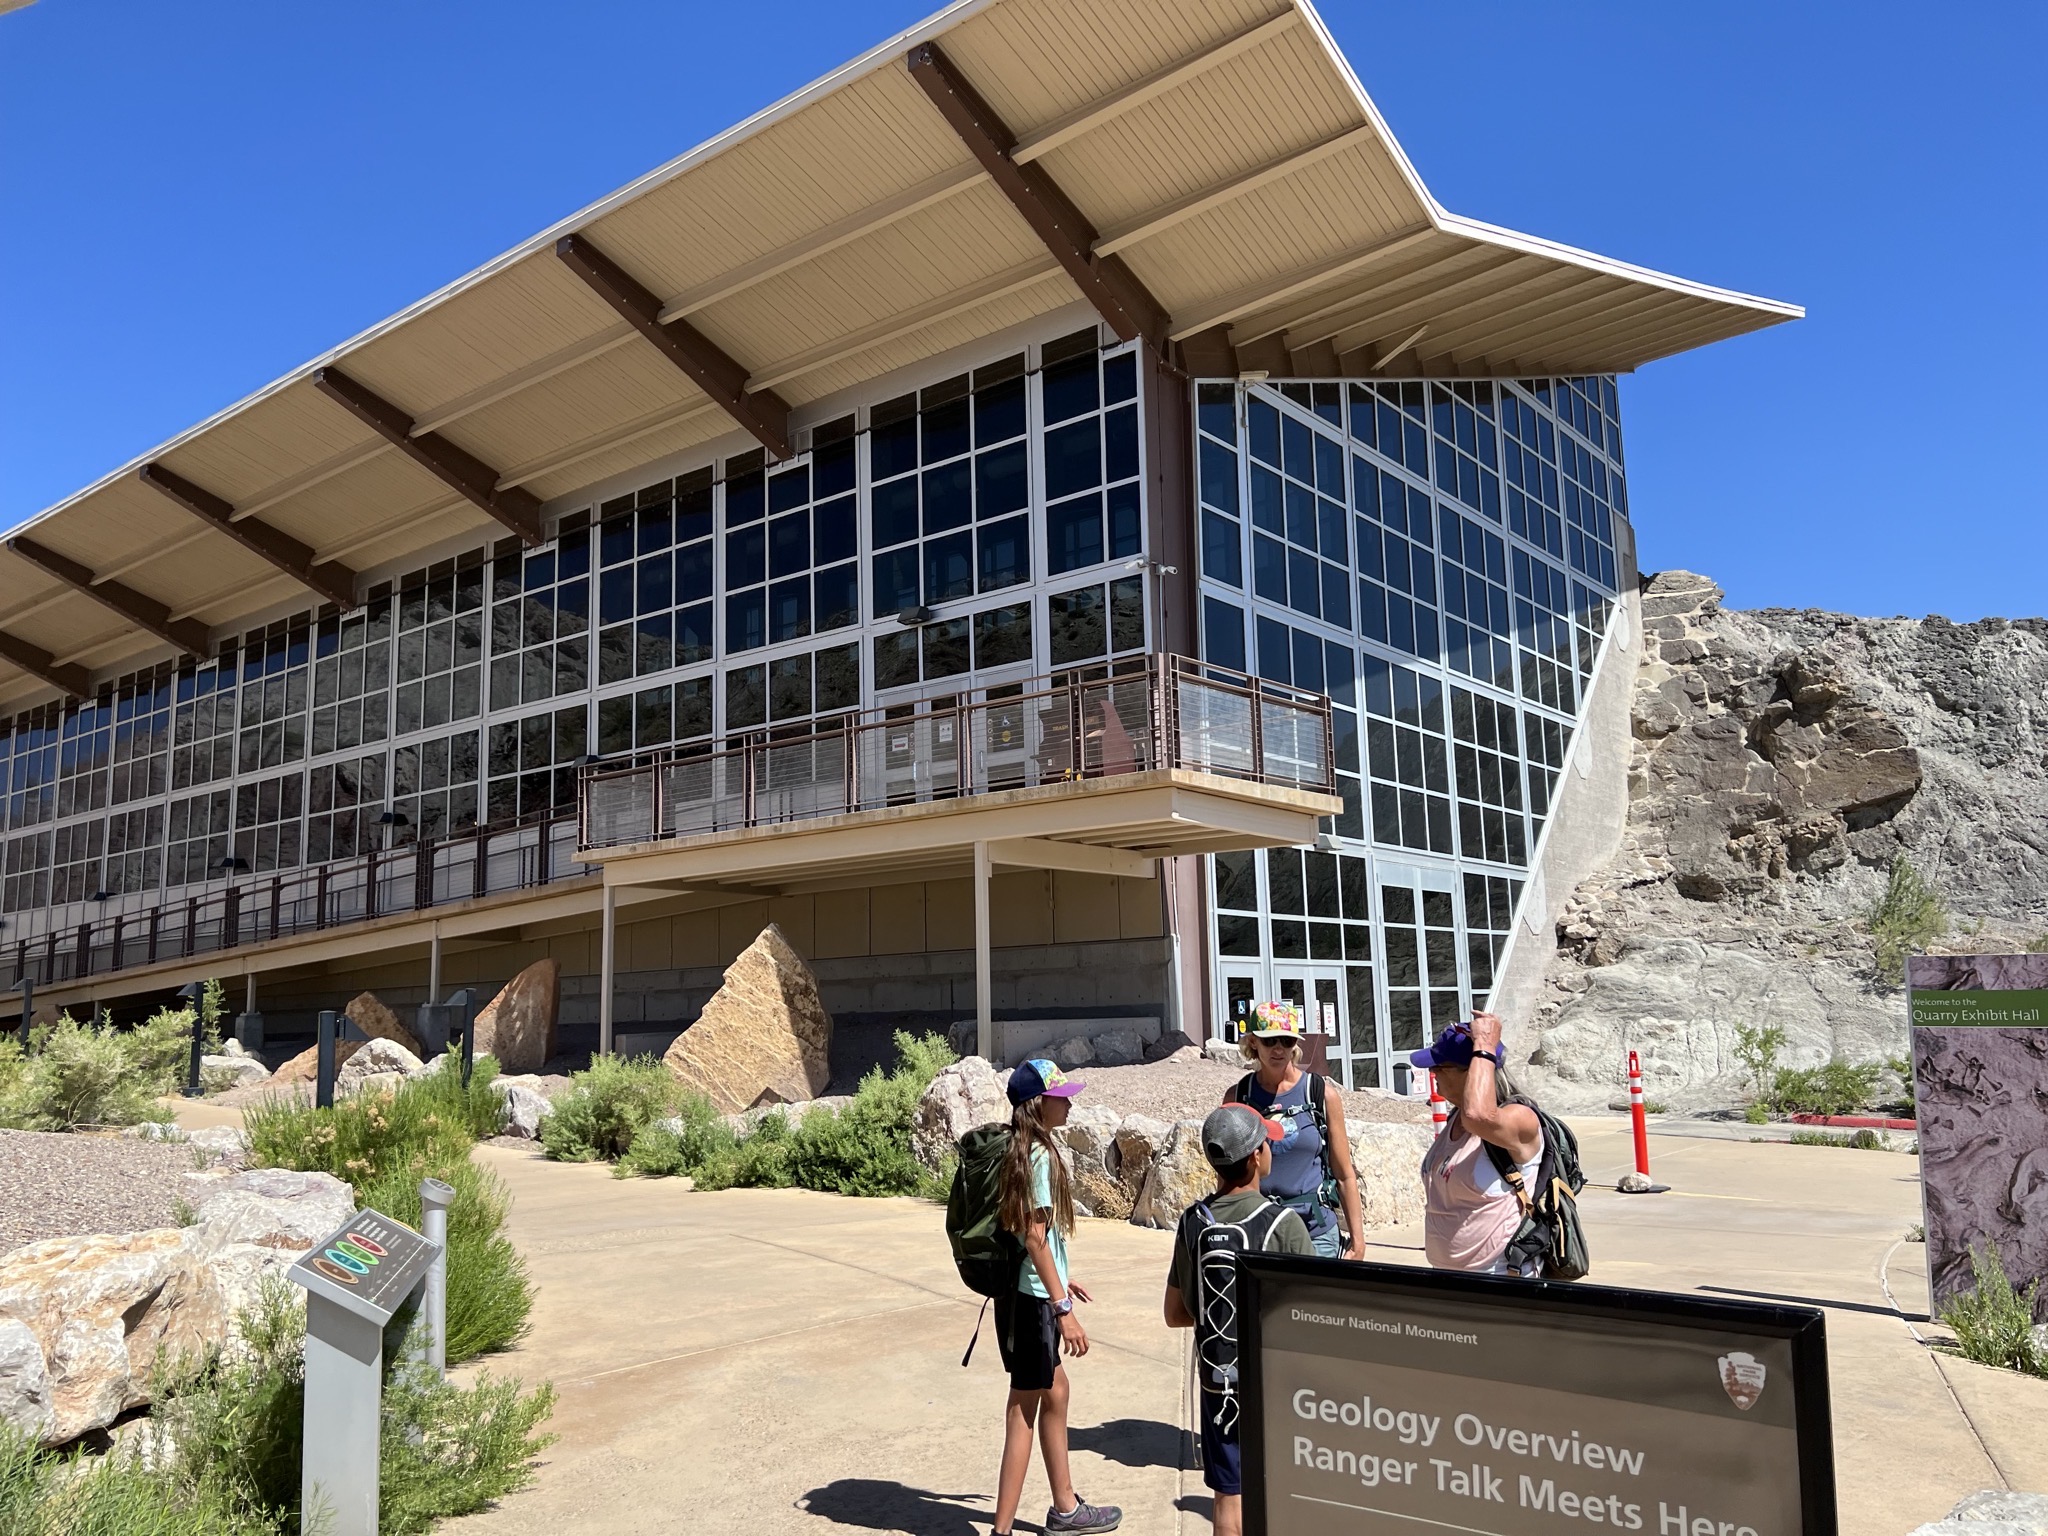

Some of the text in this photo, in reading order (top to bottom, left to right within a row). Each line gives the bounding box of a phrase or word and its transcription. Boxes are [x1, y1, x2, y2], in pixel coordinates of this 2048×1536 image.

[1912, 998, 1950, 1006] Welcome
[1962, 998, 1977, 1006] the
[1912, 1009, 2040, 1024] Quarry Exhibit Hall
[1291, 1308, 1478, 1346] Dinosaur National Monument
[1292, 1388, 1645, 1476] Geology Overview
[1293, 1435, 1418, 1487] Ranger
[1429, 1458, 1505, 1503] Talk
[1518, 1474, 1643, 1530] Meets
